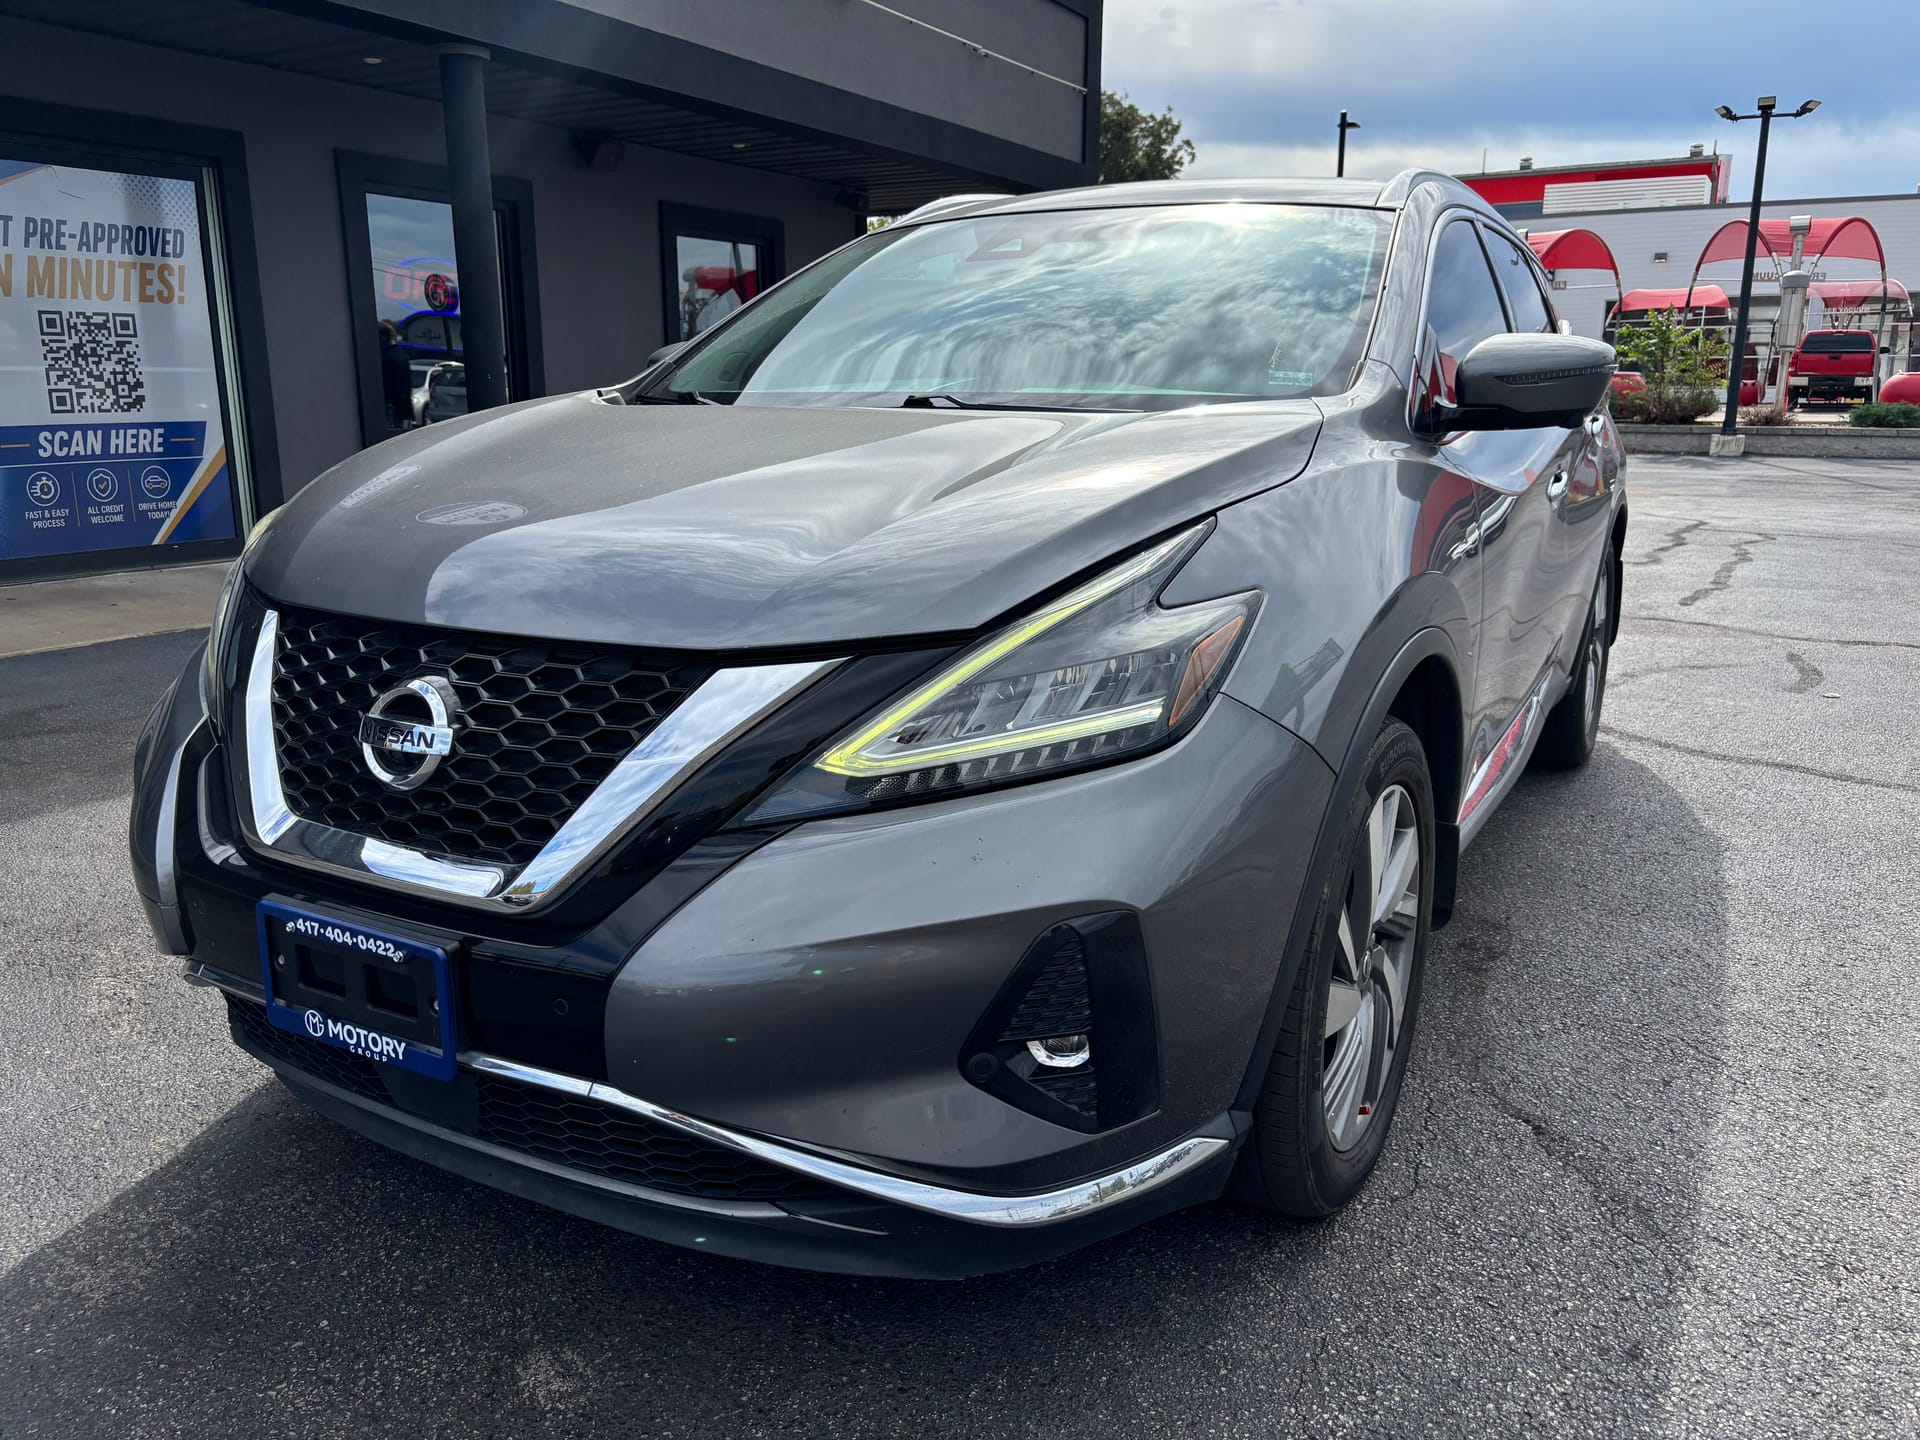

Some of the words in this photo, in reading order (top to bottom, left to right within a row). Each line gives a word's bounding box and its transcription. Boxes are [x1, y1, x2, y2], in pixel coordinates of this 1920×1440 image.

[24, 216, 185, 259] PRE-APPROVED
[27, 255, 186, 305] MINUTES!
[38, 430, 102, 458] SCAN
[110, 428, 165, 454] HERE
[88, 505, 100, 515] ALL
[101, 504, 125, 514] CREDIT
[138, 502, 157, 511] DRIVE
[158, 500, 177, 510] HOME
[25, 510, 44, 520] FAST
[45, 510, 50, 519] &
[52, 508, 70, 518] EASY
[91, 514, 125, 524] WELCOME
[147, 510, 170, 520] TODAY!
[33, 518, 66, 529] PROCESS
[327, 1019, 407, 1060] MOTORY
[350, 1045, 388, 1062] GROUP
